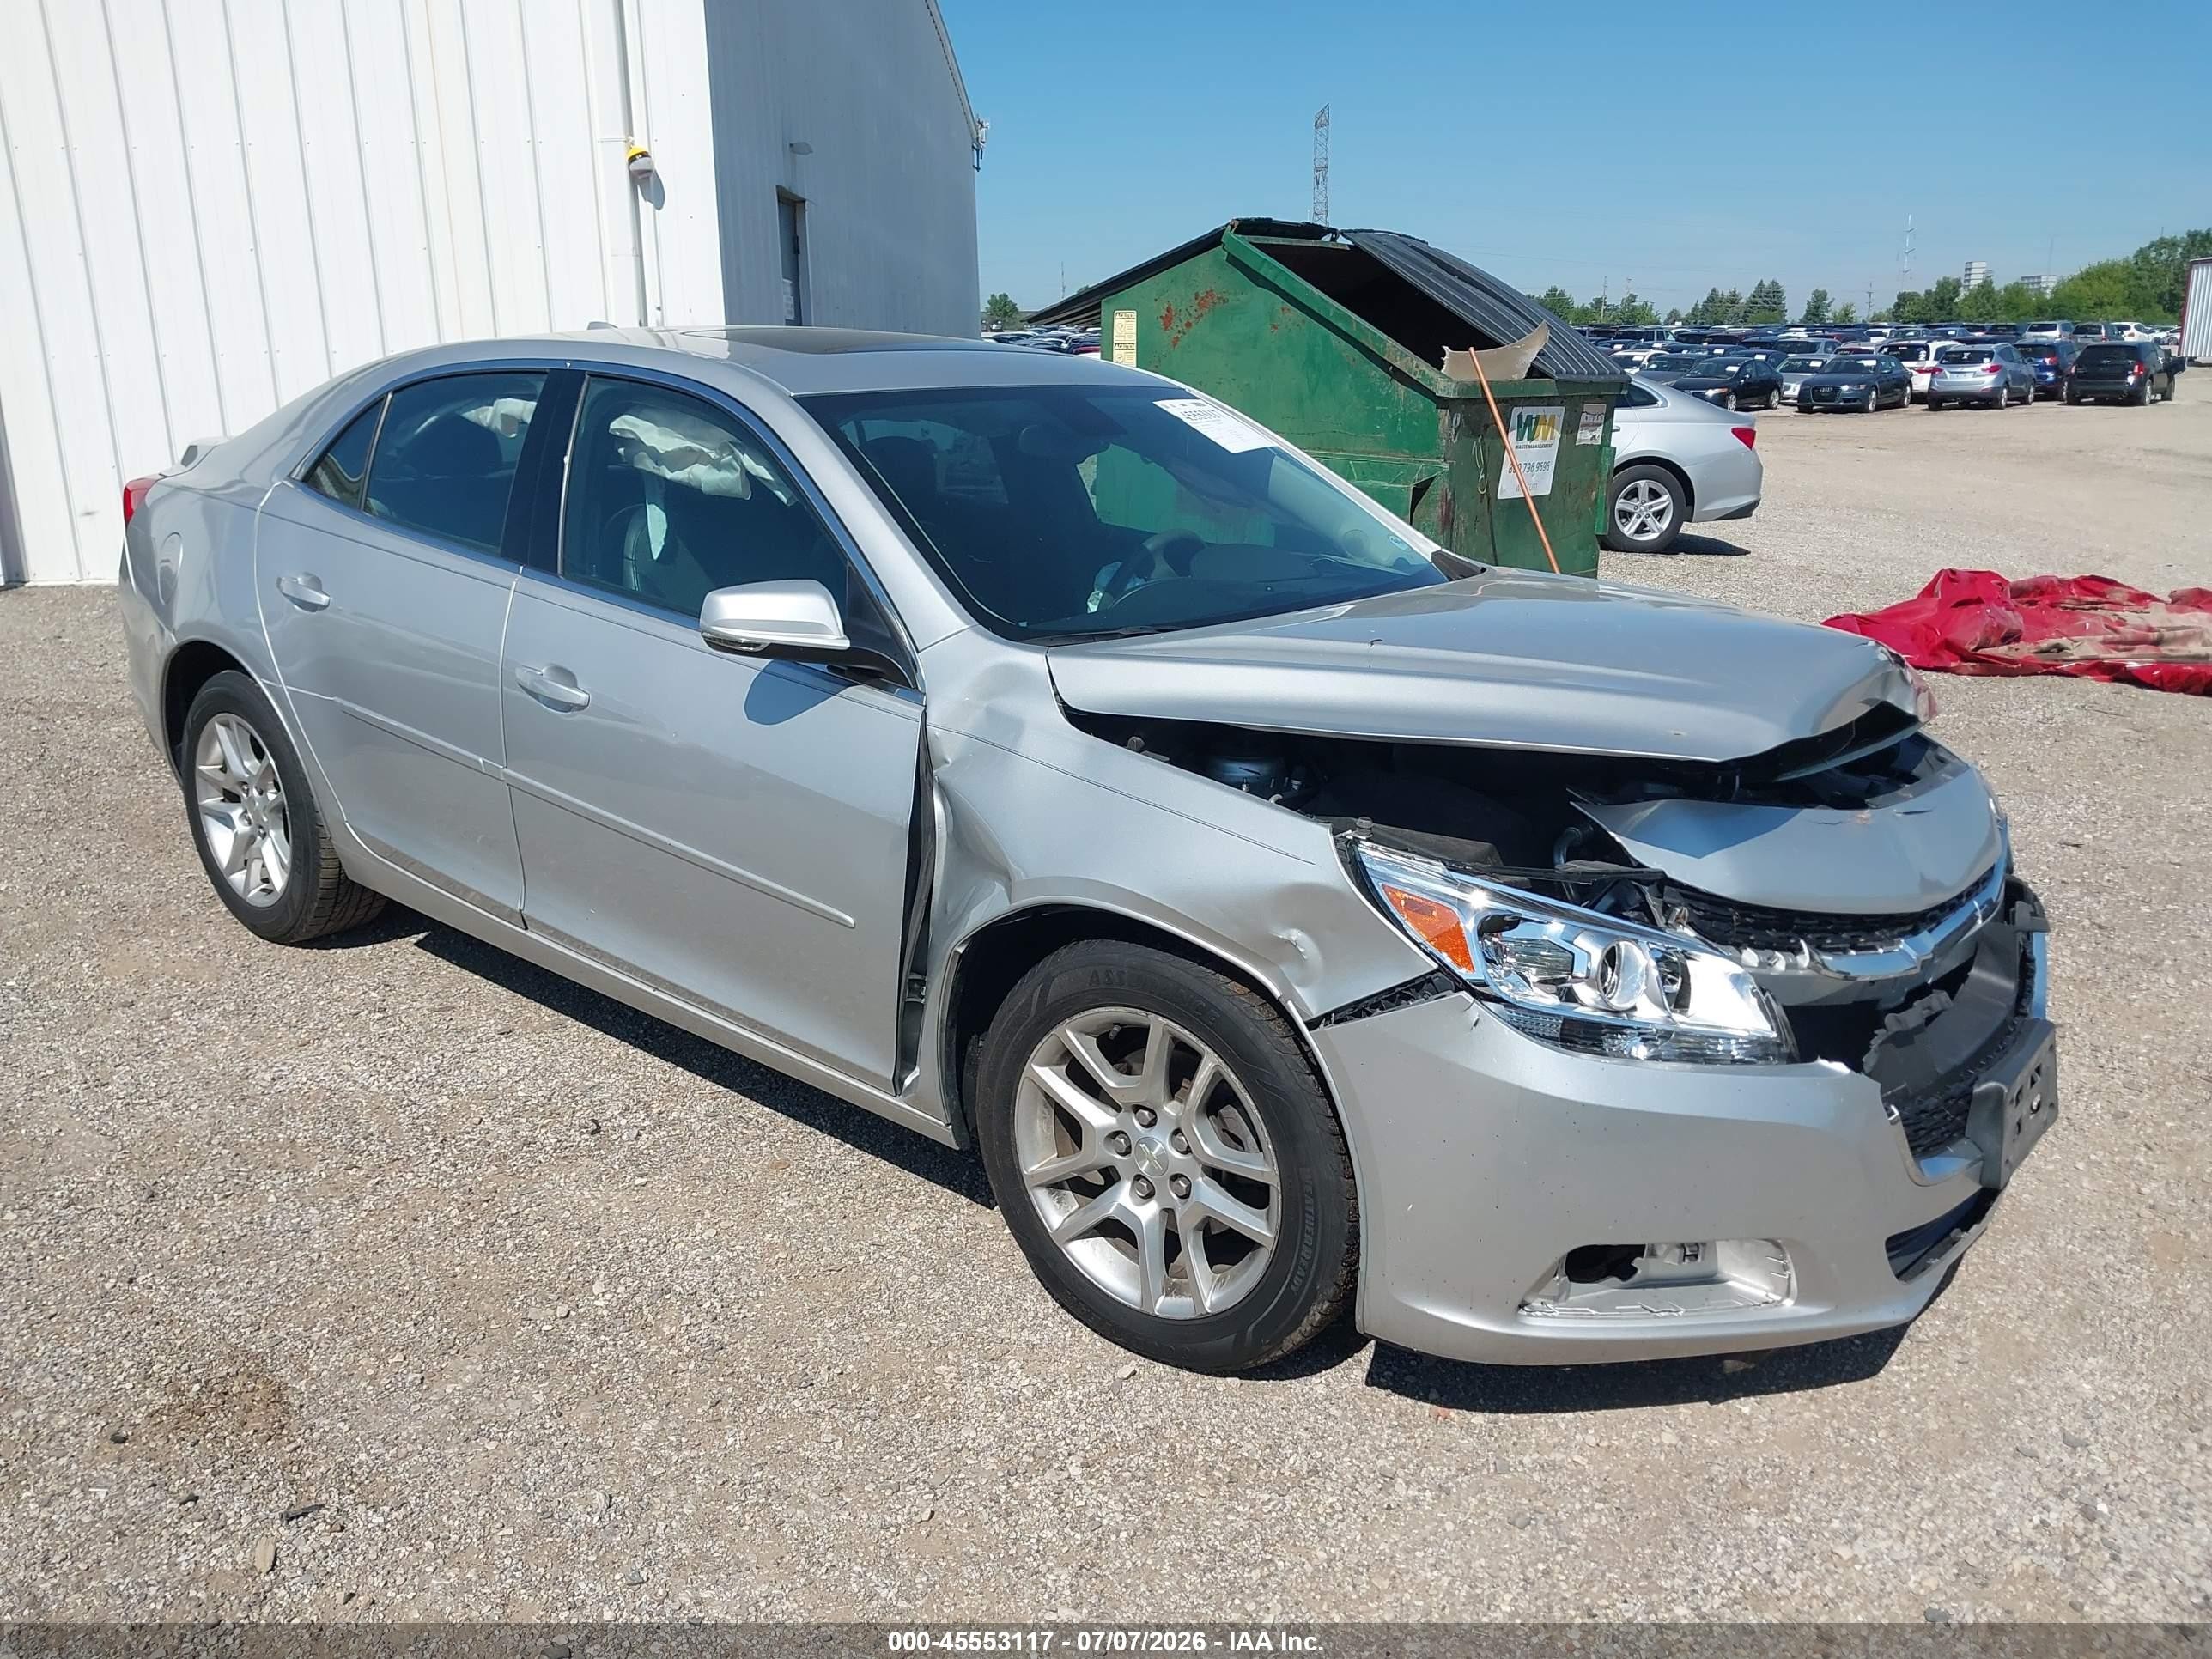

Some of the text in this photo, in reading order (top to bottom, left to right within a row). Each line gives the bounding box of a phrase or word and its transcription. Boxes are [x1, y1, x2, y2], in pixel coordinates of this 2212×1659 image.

[1517, 414, 1556, 441] WM
[1523, 463, 1534, 473] 796
[1535, 461, 1551, 472] 9696
